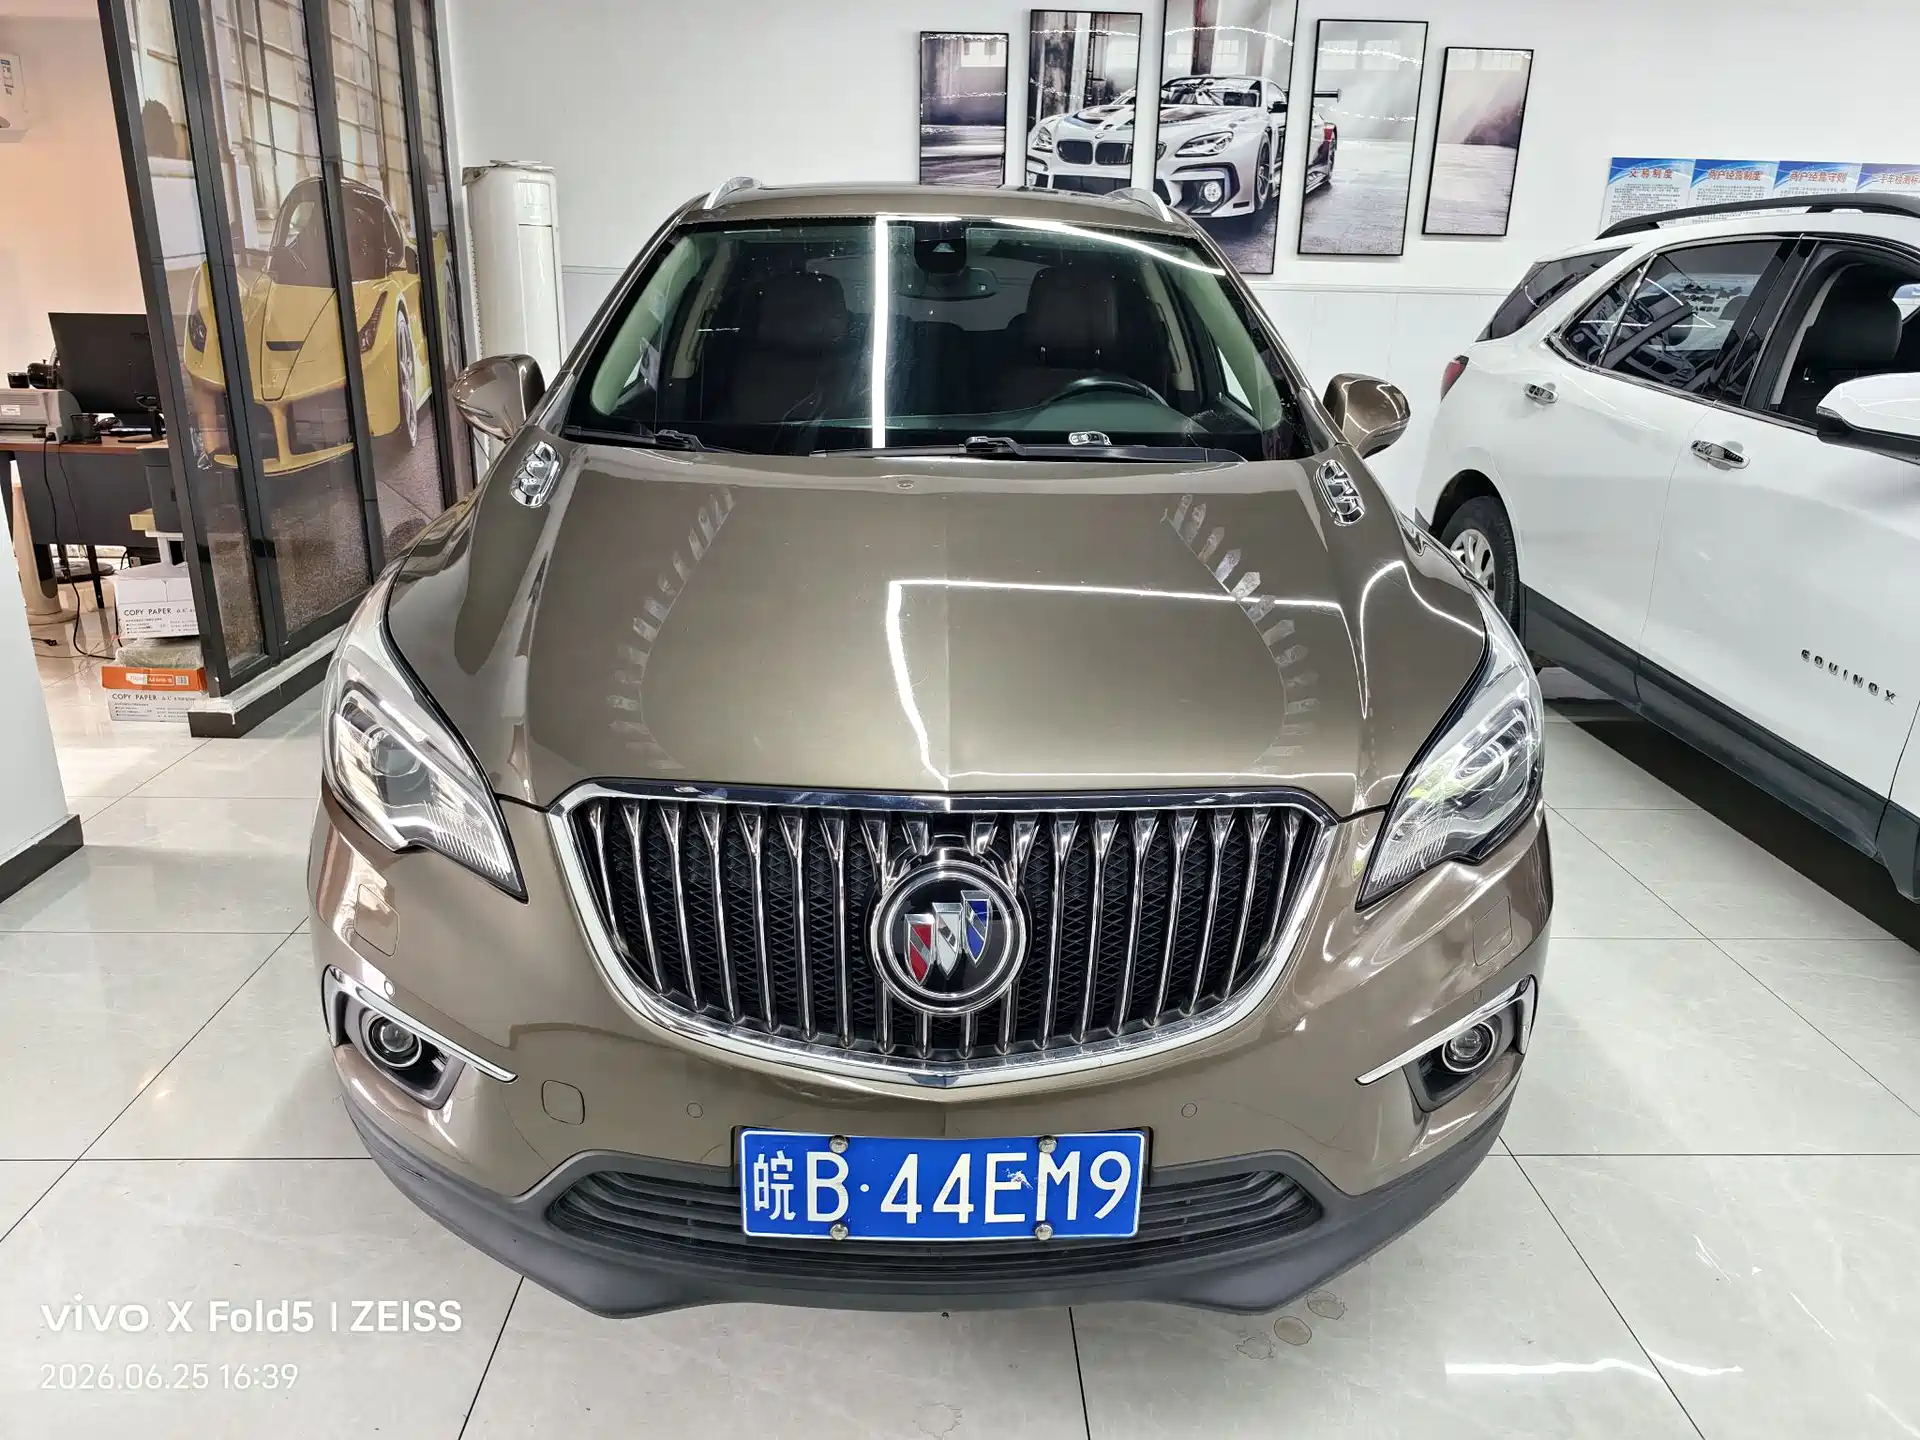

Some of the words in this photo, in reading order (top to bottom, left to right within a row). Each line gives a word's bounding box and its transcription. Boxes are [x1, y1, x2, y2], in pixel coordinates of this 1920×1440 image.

[124, 608, 144, 617] COPY
[148, 607, 172, 615] PAPER
[1800, 648, 1896, 706] EQUINOX
[112, 693, 131, 701] COPY
